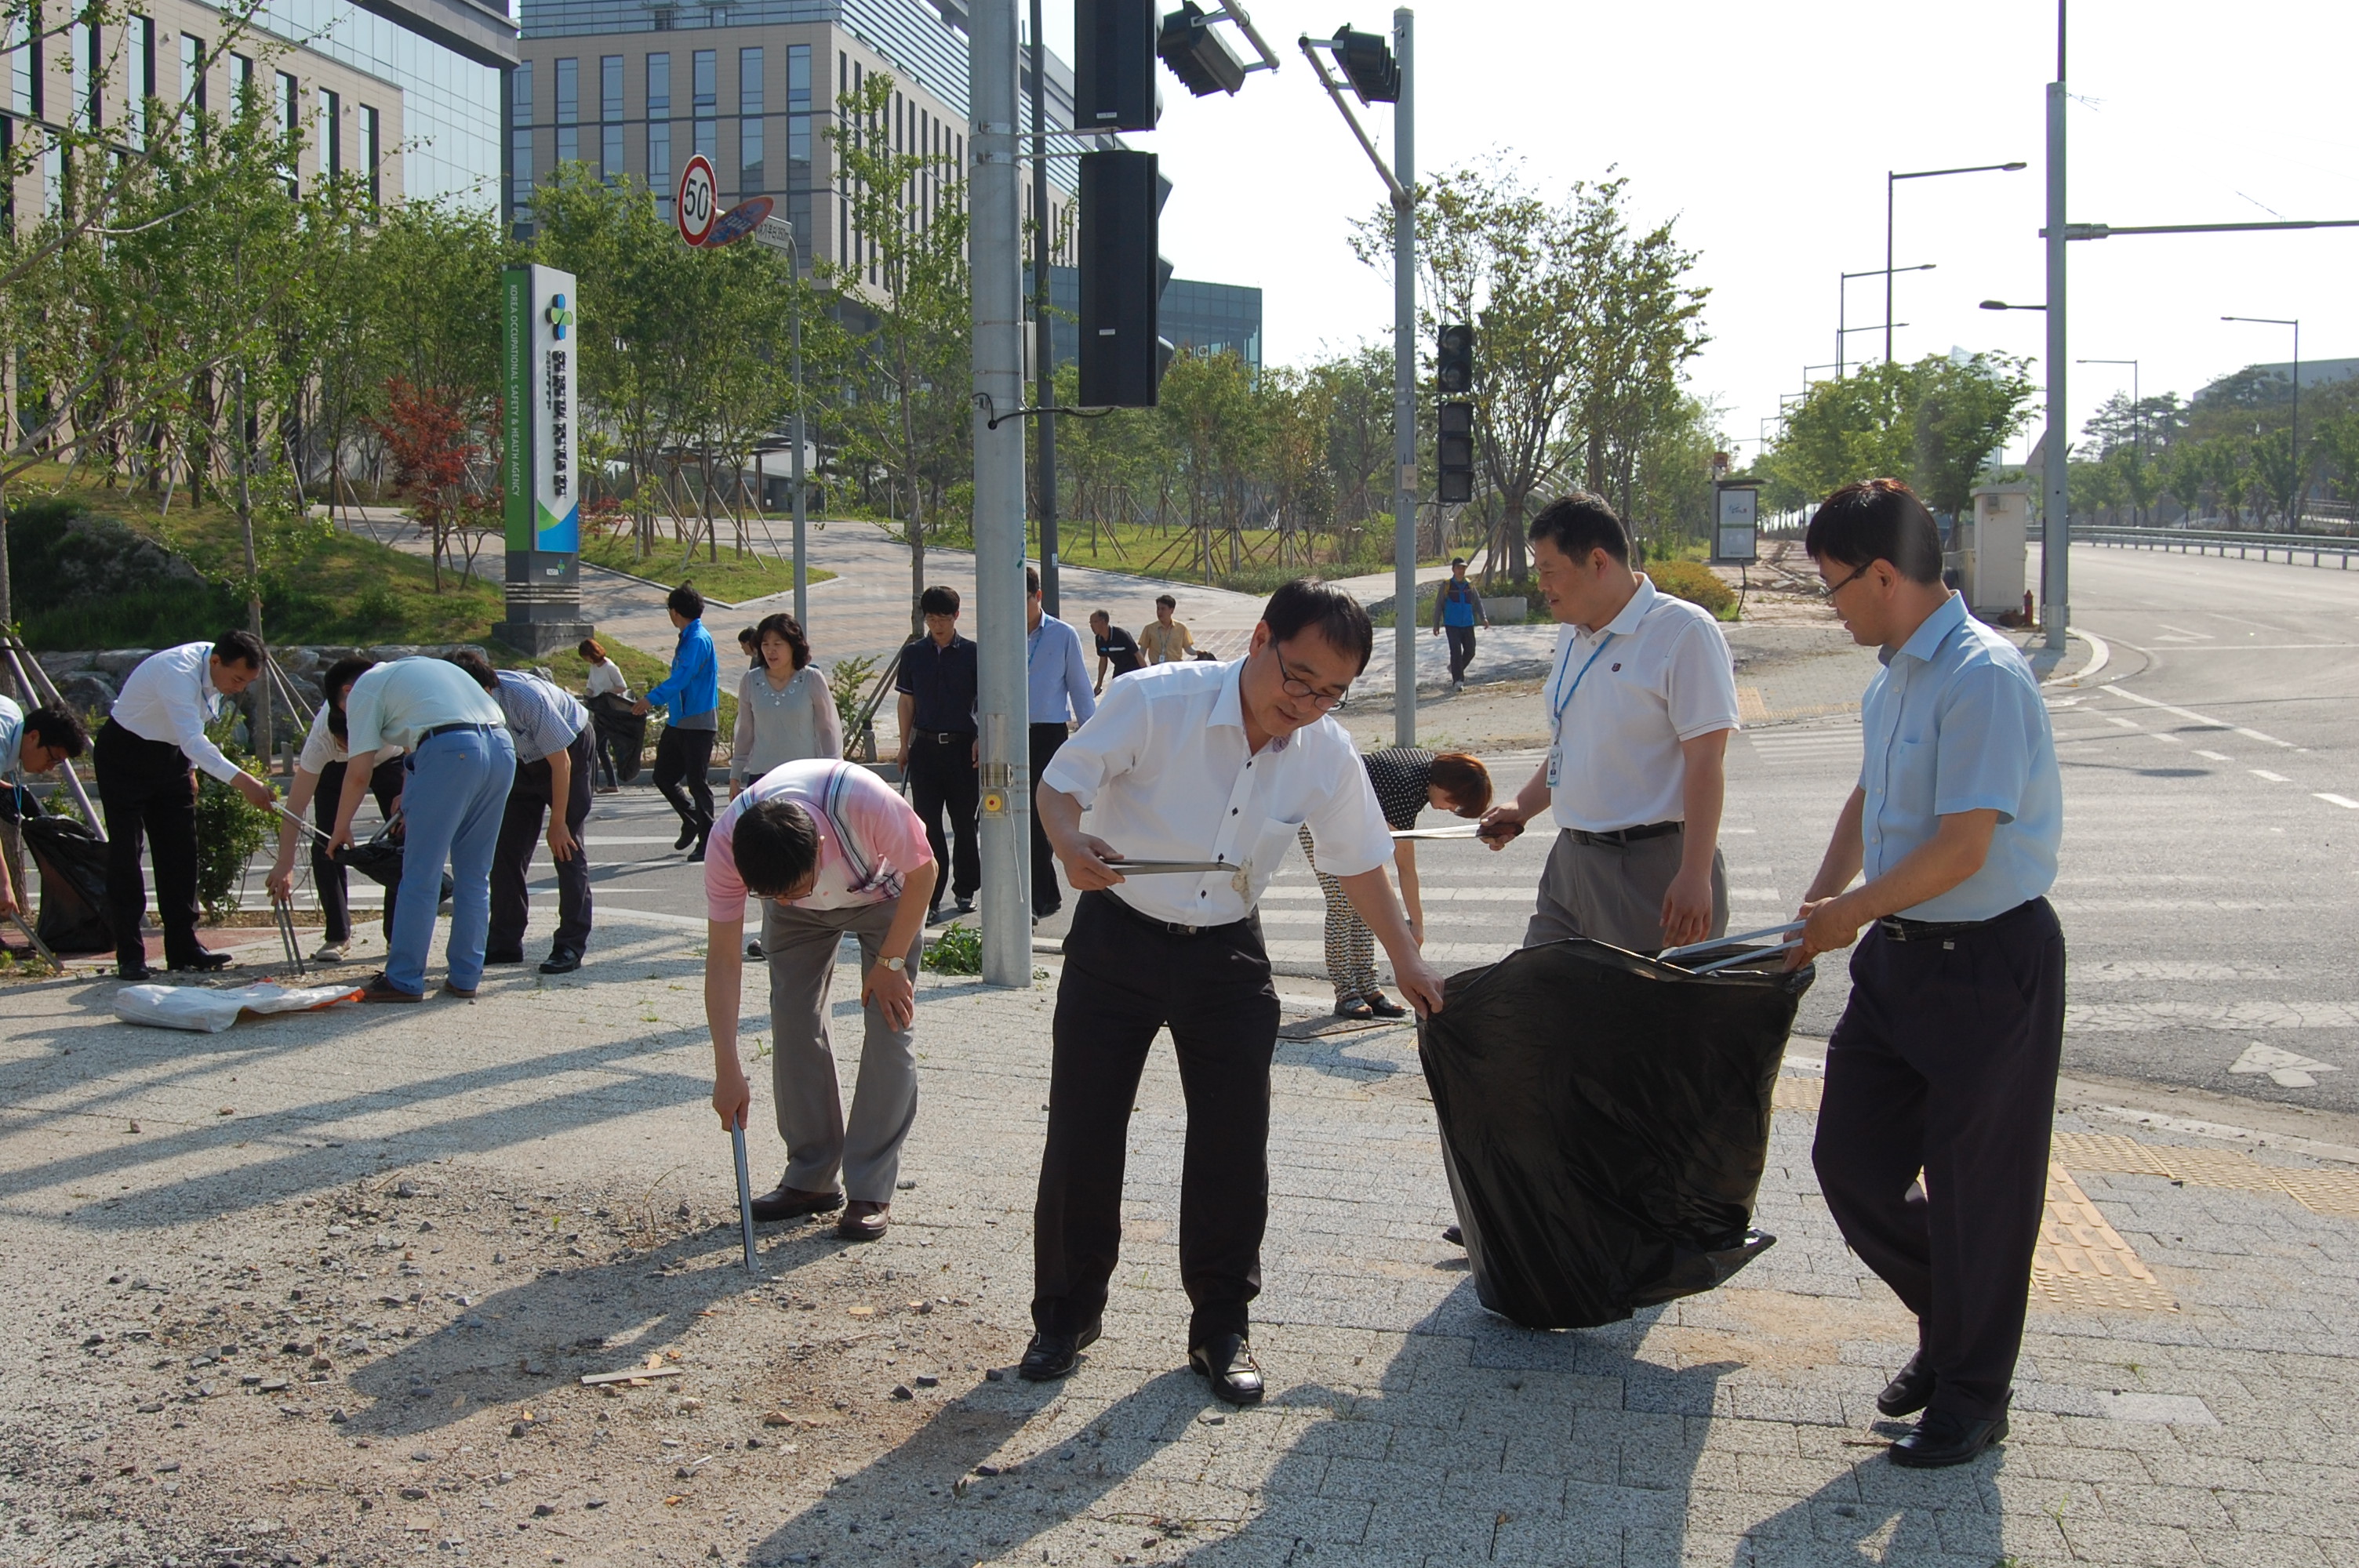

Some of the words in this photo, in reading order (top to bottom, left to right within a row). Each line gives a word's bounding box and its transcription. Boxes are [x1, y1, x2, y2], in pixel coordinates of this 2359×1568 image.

[684, 177, 709, 221] 50
[510, 284, 518, 313] KOREA
[511, 315, 519, 381] OCCUPATIONAL
[511, 461, 520, 496] AGENCY
